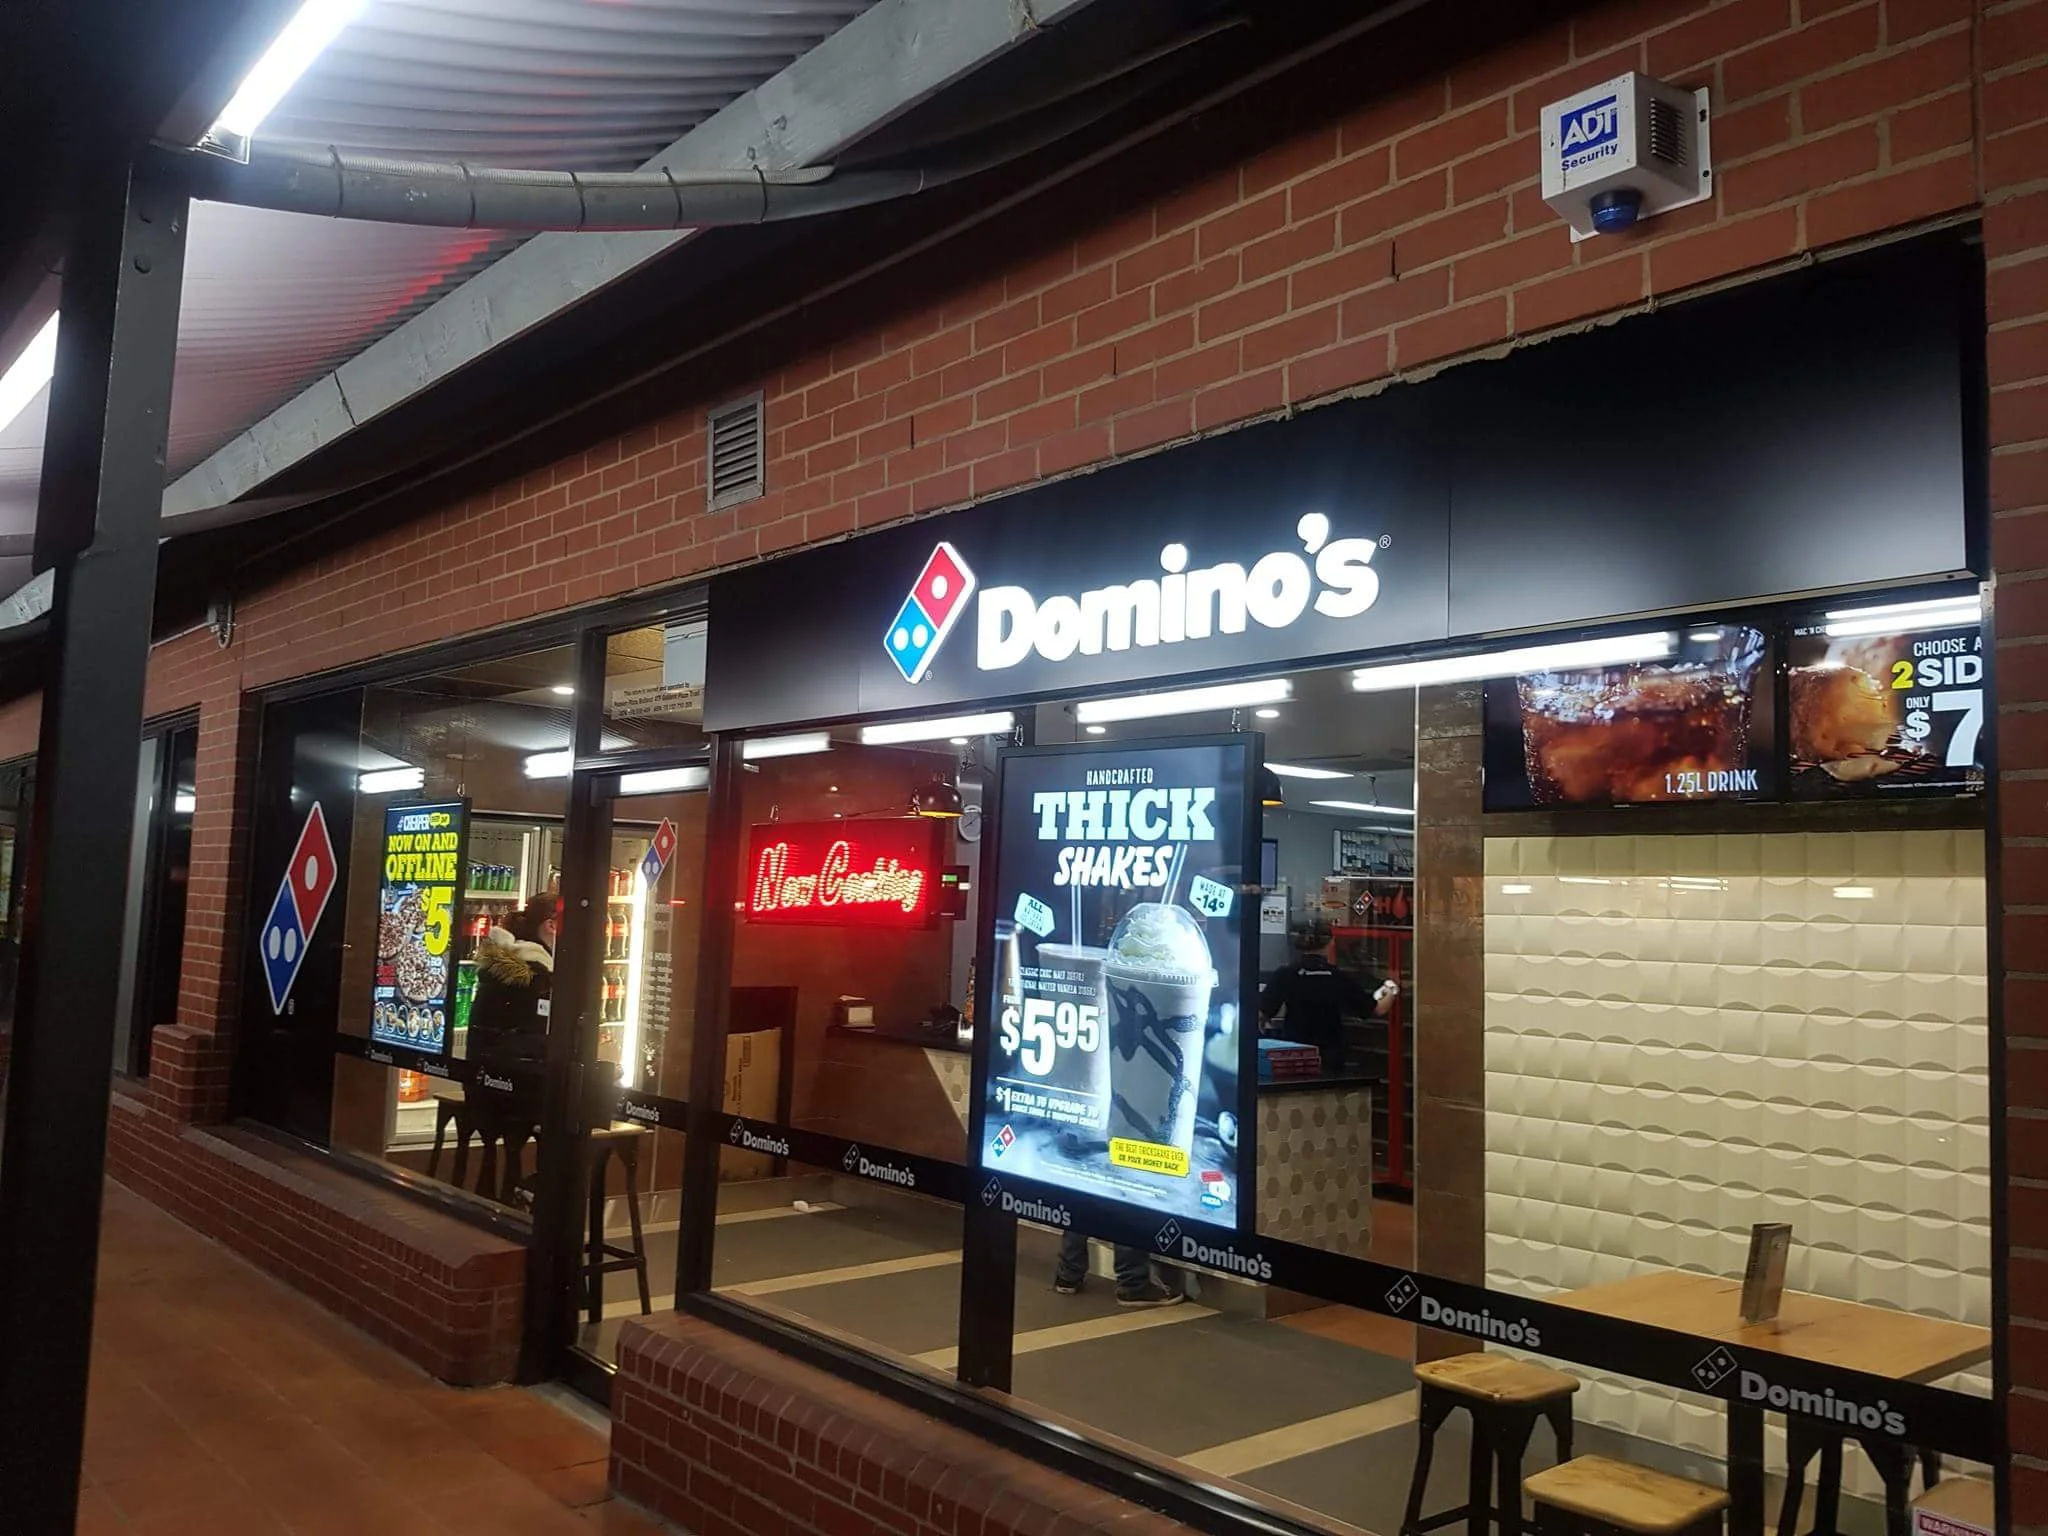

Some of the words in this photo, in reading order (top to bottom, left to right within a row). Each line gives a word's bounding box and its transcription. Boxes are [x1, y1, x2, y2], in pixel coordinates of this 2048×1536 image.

[1561, 102, 1617, 150] ADT
[1561, 144, 1618, 171] Security
[975, 512, 1380, 670] Domino's
[1913, 638, 1967, 656] CHOOSE
[1892, 661, 1914, 689] 2
[1906, 696, 1930, 709] ONLY
[1086, 768, 1154, 786] HANDCRAFTED
[1665, 774, 1703, 795] 1.25L
[1707, 770, 1759, 793] DRINK
[1033, 787, 1215, 841] THICK
[388, 834, 414, 852] NOW
[415, 833, 432, 852] ON
[432, 832, 458, 851] AND
[386, 852, 457, 881] OFFLINE
[753, 843, 817, 912] Now
[1053, 846, 1174, 889] SHAKES
[421, 886, 452, 956] $5
[484, 1074, 513, 1092] Domino's
[626, 1100, 660, 1122] Domino's
[996, 1087, 1011, 1111] $1
[743, 1130, 789, 1156] Domino's
[859, 1157, 915, 1187] Domino's
[1002, 1191, 1071, 1226] Domino's
[1182, 1236, 1272, 1279] Domino's
[1420, 1296, 1541, 1347] Domino's
[1740, 1370, 1906, 1435] Domino's
